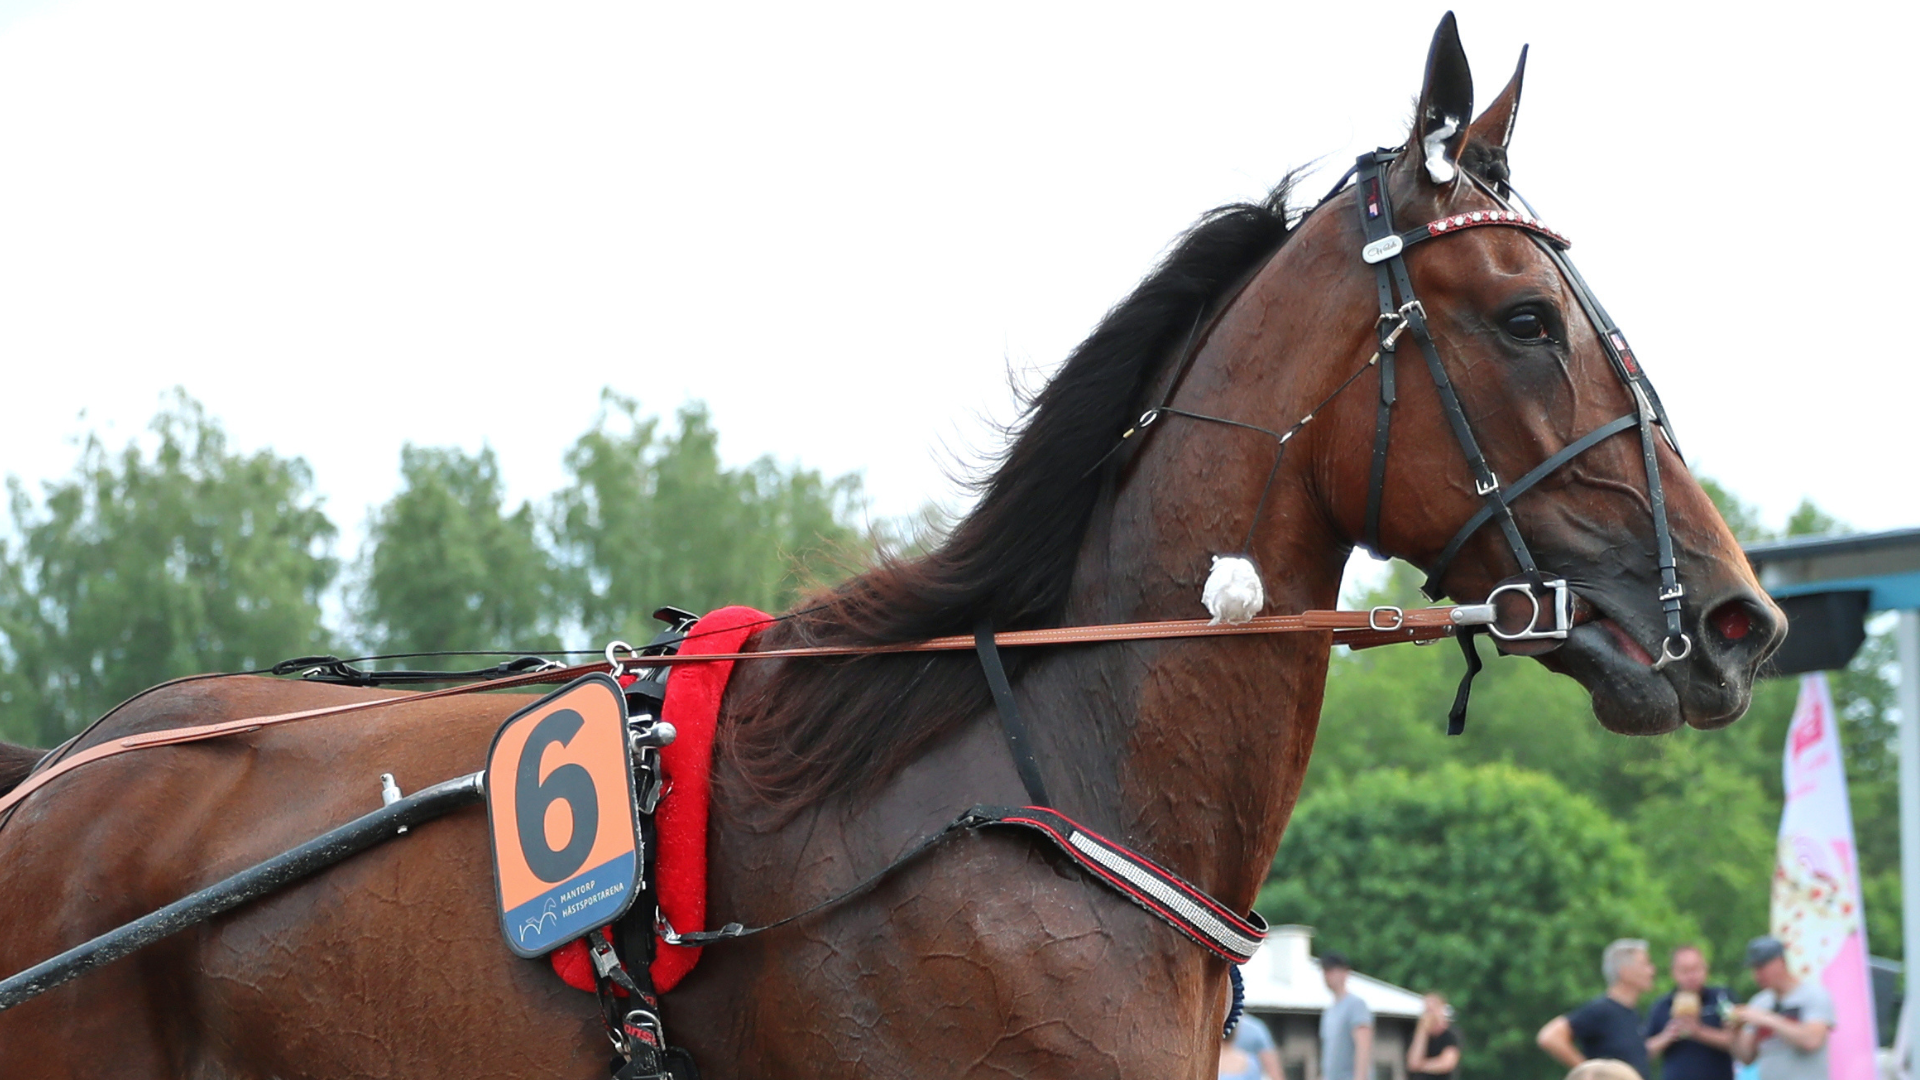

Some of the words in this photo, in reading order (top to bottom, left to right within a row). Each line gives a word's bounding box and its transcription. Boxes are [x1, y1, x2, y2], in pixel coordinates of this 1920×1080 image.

[515, 709, 598, 883] 6
[560, 880, 596, 904] MANTORP
[562, 882, 625, 918] HÄSTSPORTARENA
